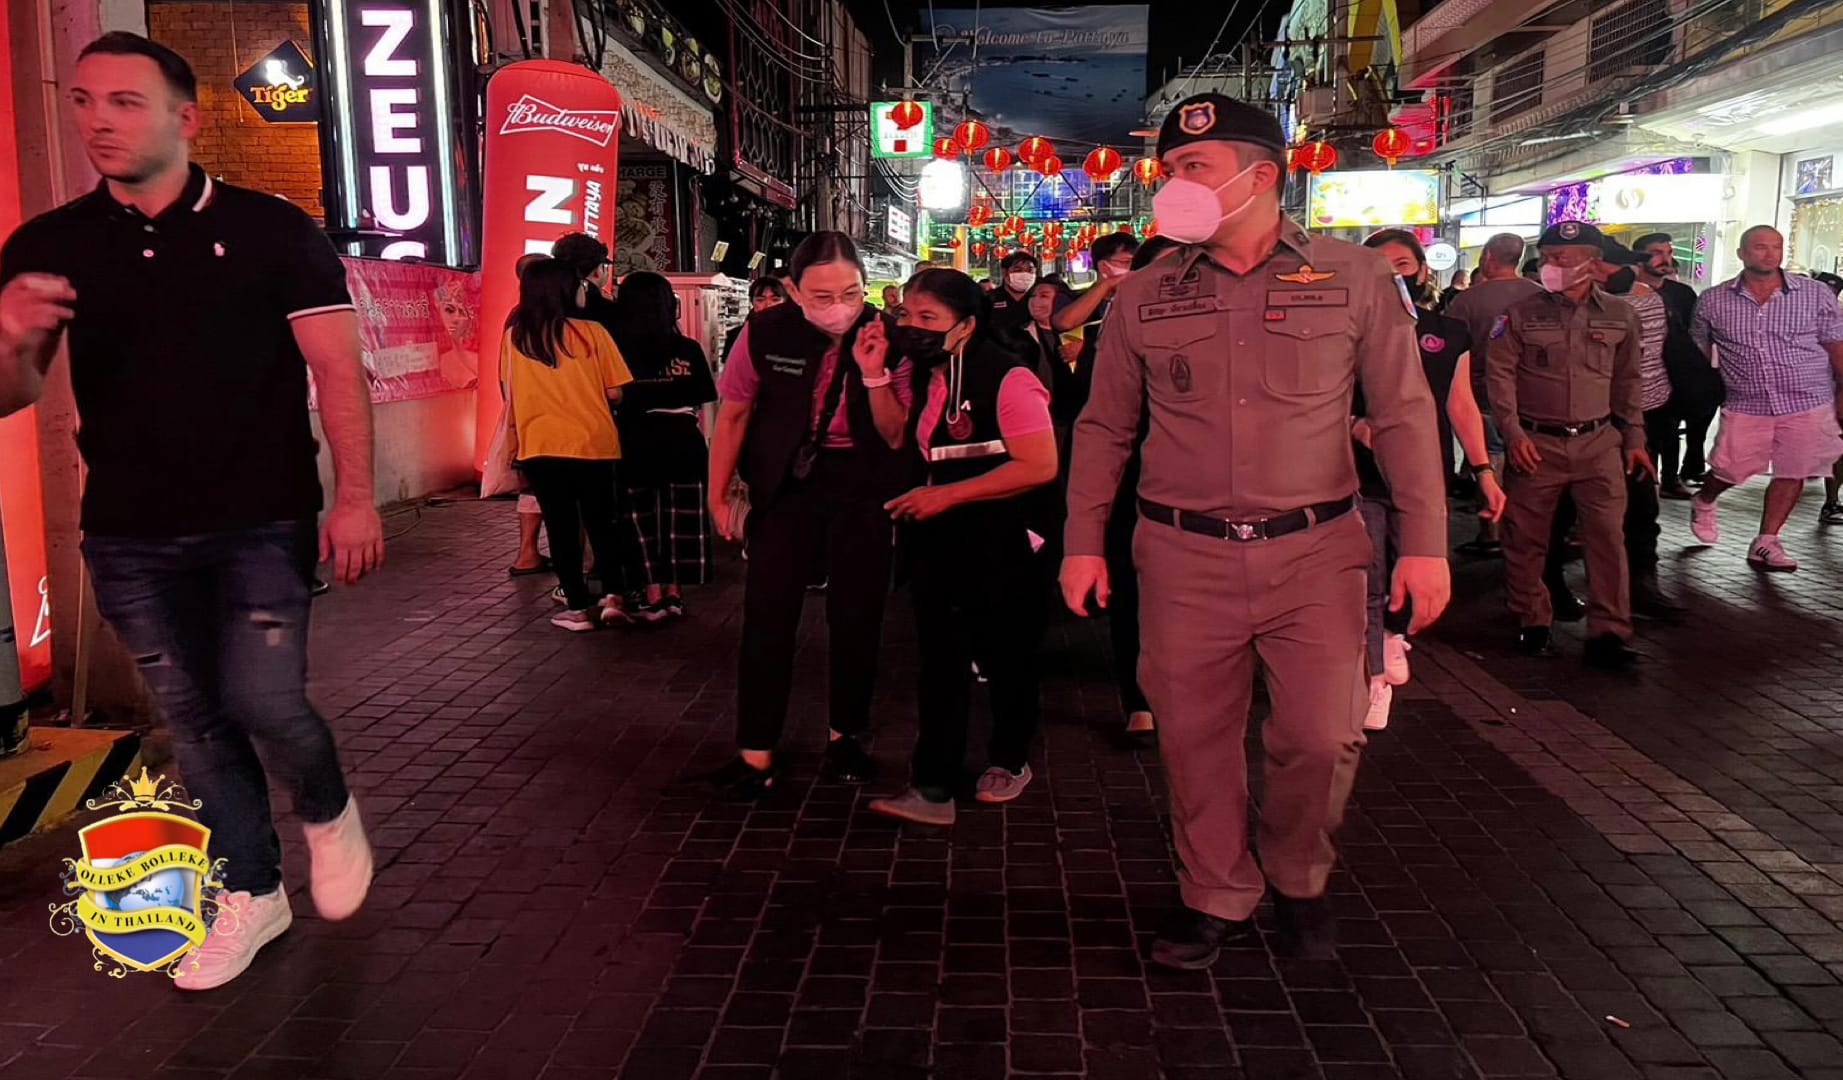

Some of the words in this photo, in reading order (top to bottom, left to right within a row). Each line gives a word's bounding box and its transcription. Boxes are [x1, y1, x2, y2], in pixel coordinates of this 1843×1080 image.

[1035, 31, 1054, 44] to
[1062, 28, 1132, 49] Pattaya
[250, 85, 310, 111] Tiger
[507, 102, 613, 134] Budweiser
